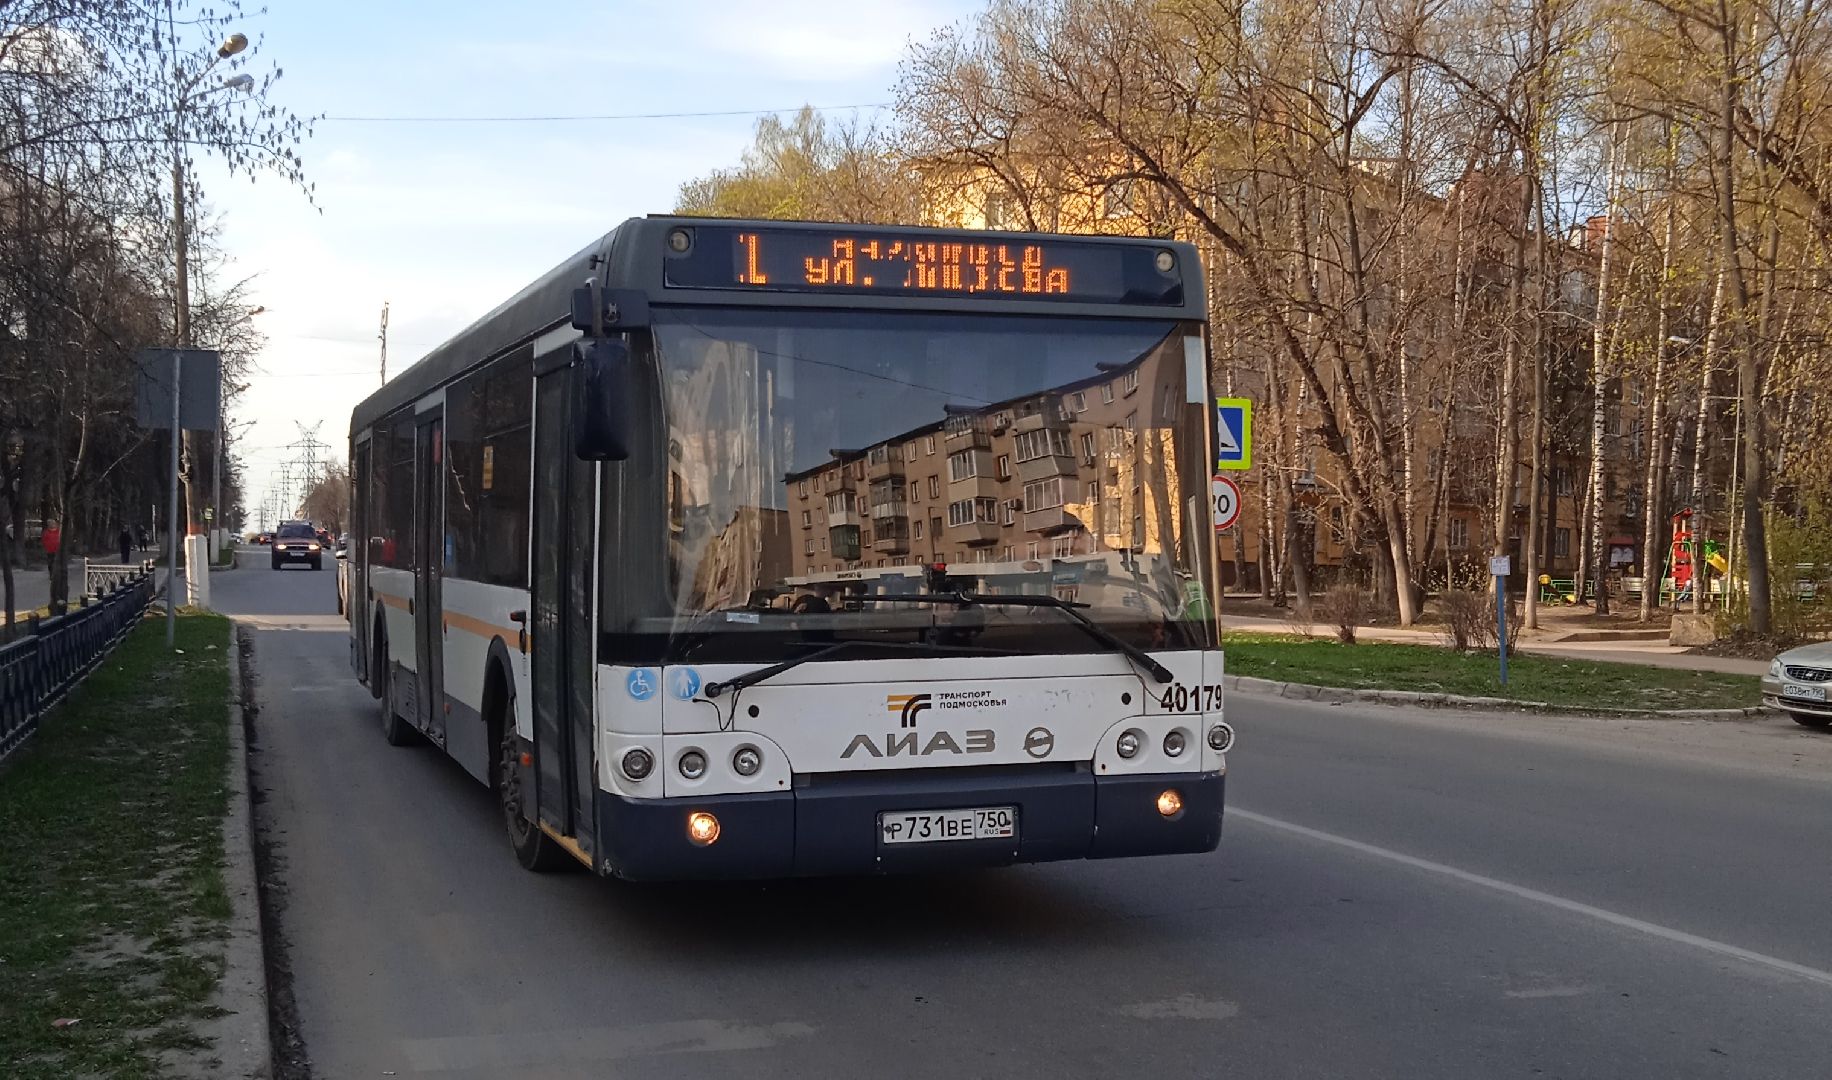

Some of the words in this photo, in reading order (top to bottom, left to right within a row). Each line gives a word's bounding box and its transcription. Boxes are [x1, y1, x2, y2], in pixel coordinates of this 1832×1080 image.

[938, 690, 992, 700] ТРАНСПОРТ
[939, 699, 1007, 709] ПОДМОСКОВЬЯ
[1160, 684, 1222, 712] 40179
[840, 729, 996, 758] ЛИАЗ
[891, 815, 973, 840] Р731ВЕ
[976, 811, 1008, 829] 750
